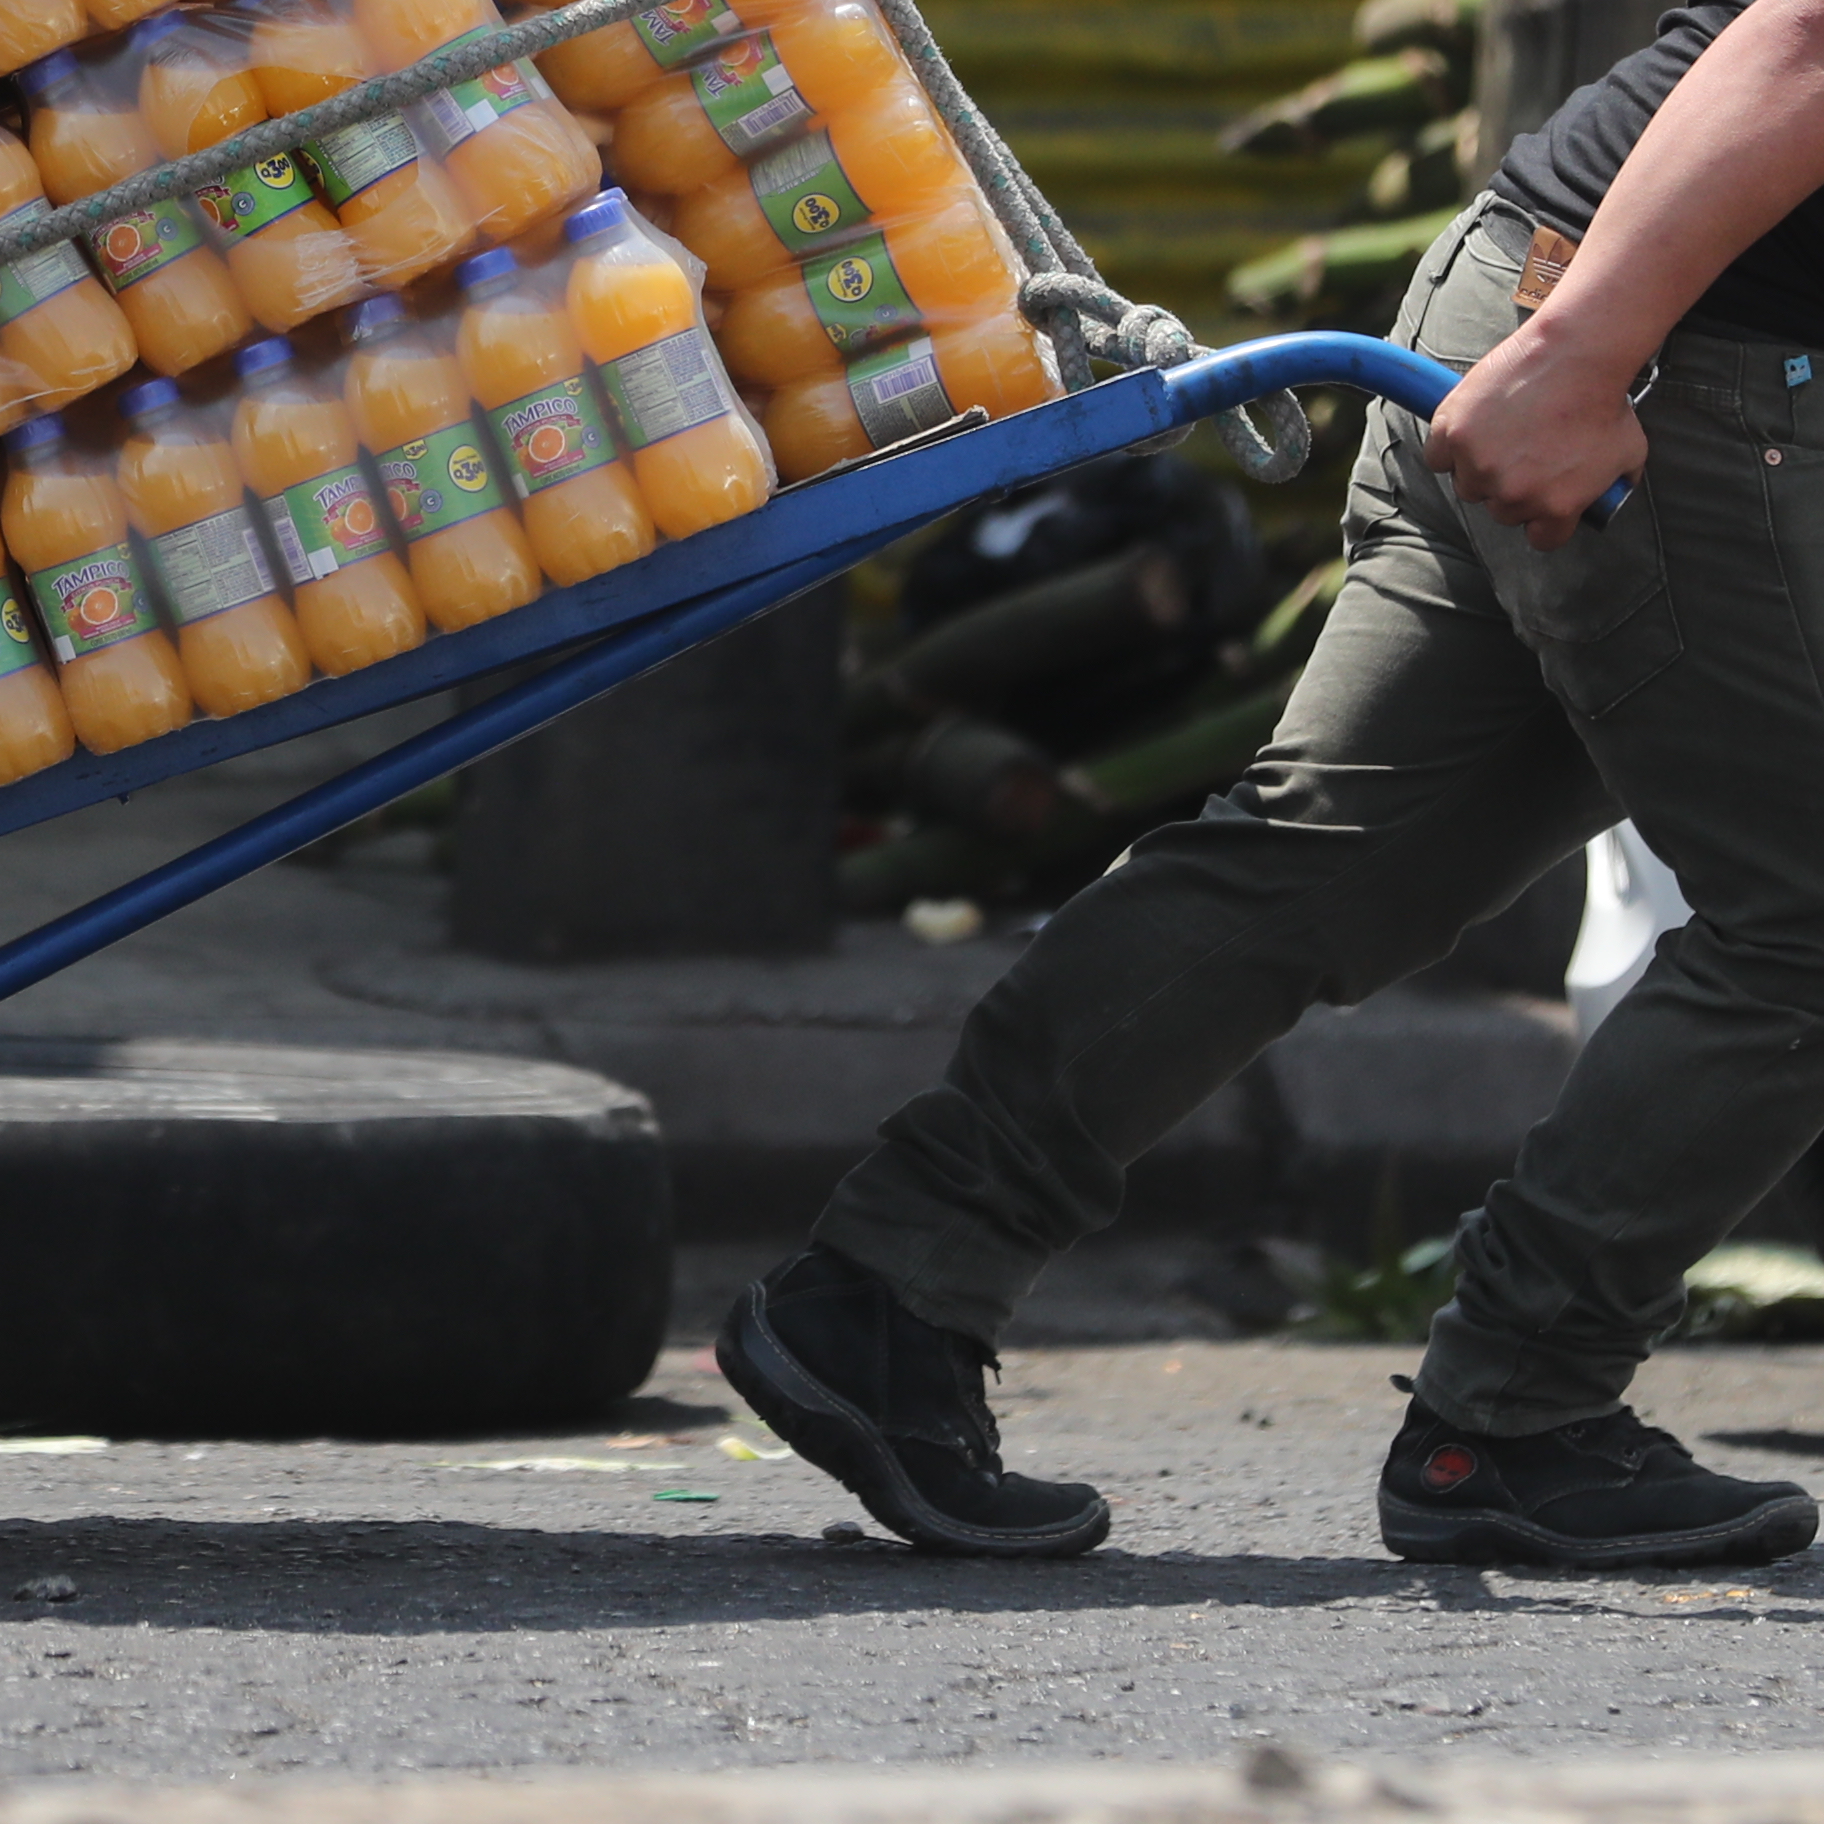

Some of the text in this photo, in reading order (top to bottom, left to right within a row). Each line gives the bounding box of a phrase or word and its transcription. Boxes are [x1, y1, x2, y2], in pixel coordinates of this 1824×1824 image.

[501, 397, 578, 436] TAMPICO
[381, 462, 416, 479] PICO
[314, 475, 366, 508] TAMP
[52, 560, 129, 599] TAMPICO
